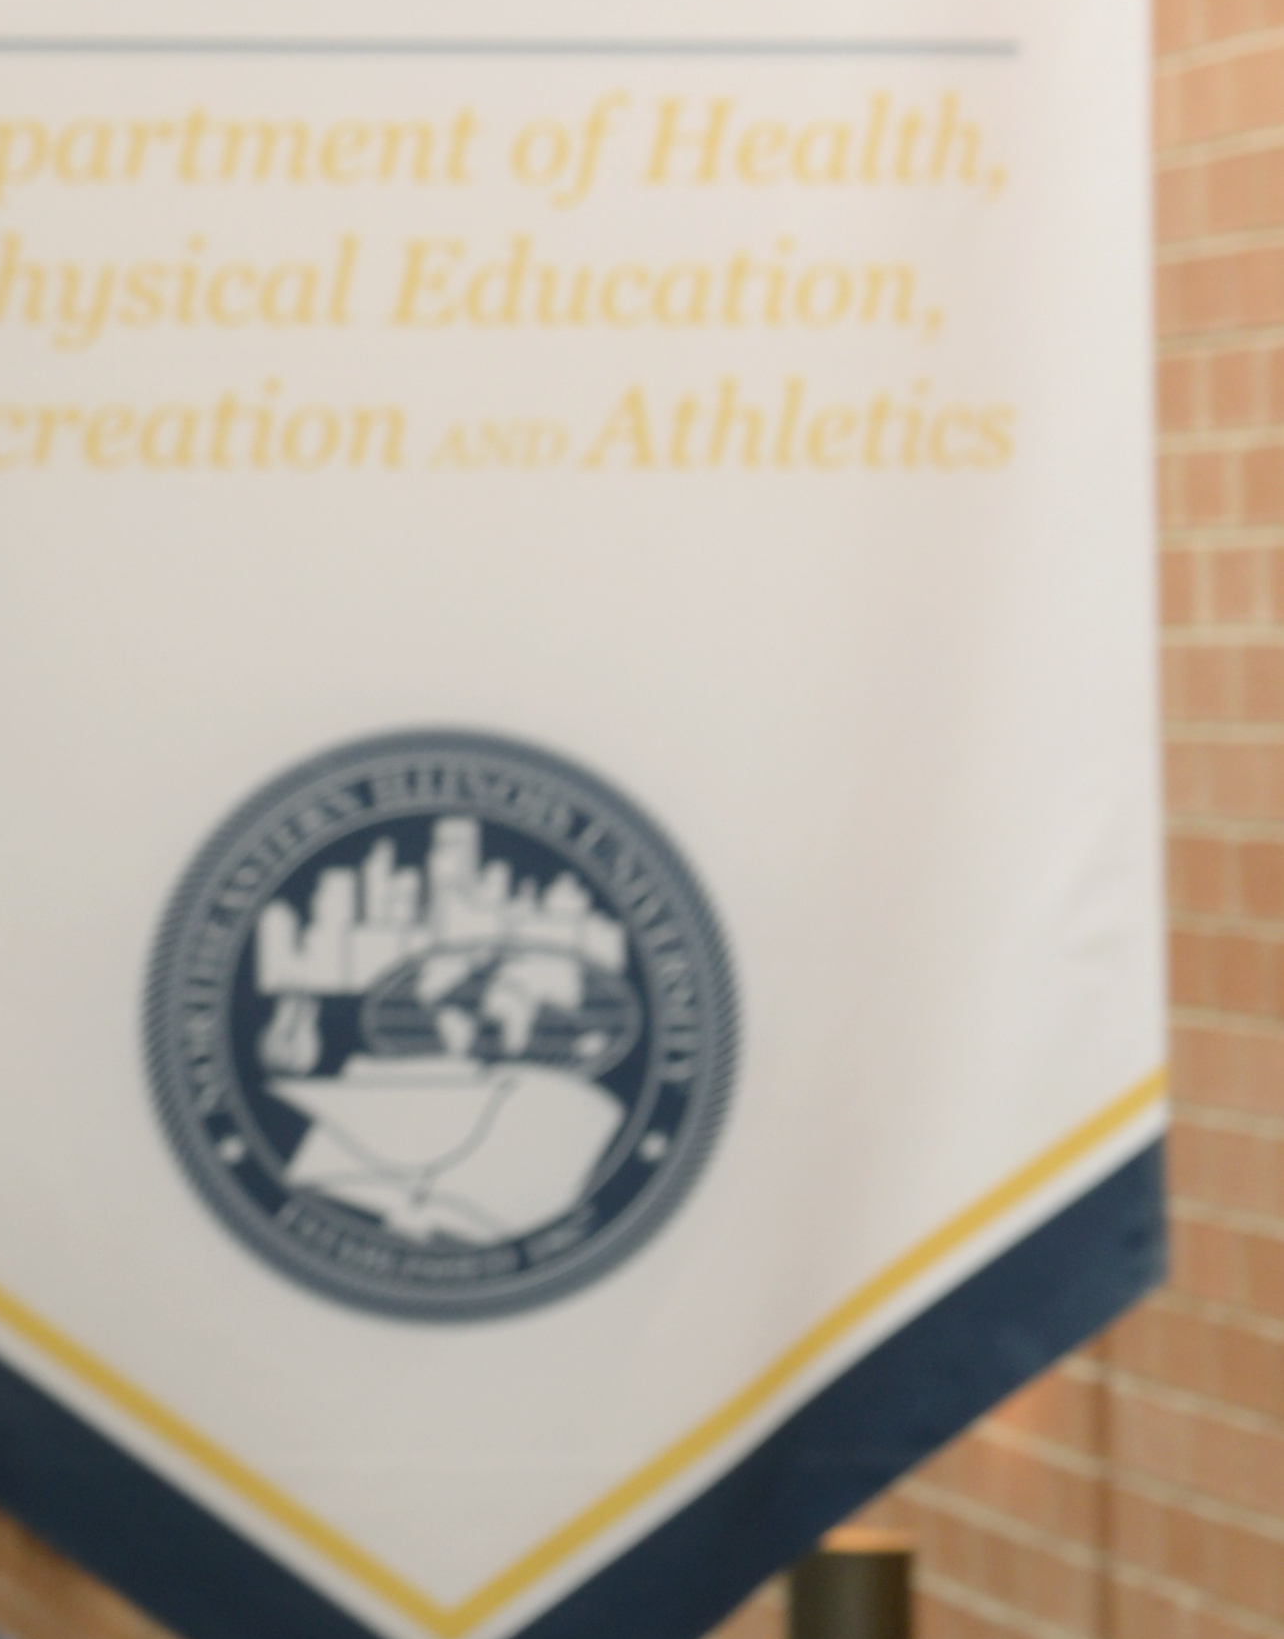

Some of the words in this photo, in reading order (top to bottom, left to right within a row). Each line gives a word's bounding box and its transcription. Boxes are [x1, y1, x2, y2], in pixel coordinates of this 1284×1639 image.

[506, 88, 632, 210] of
[638, 88, 1010, 204] Health,
[384, 230, 946, 346] Education,
[578, 372, 1018, 474] Athletics
